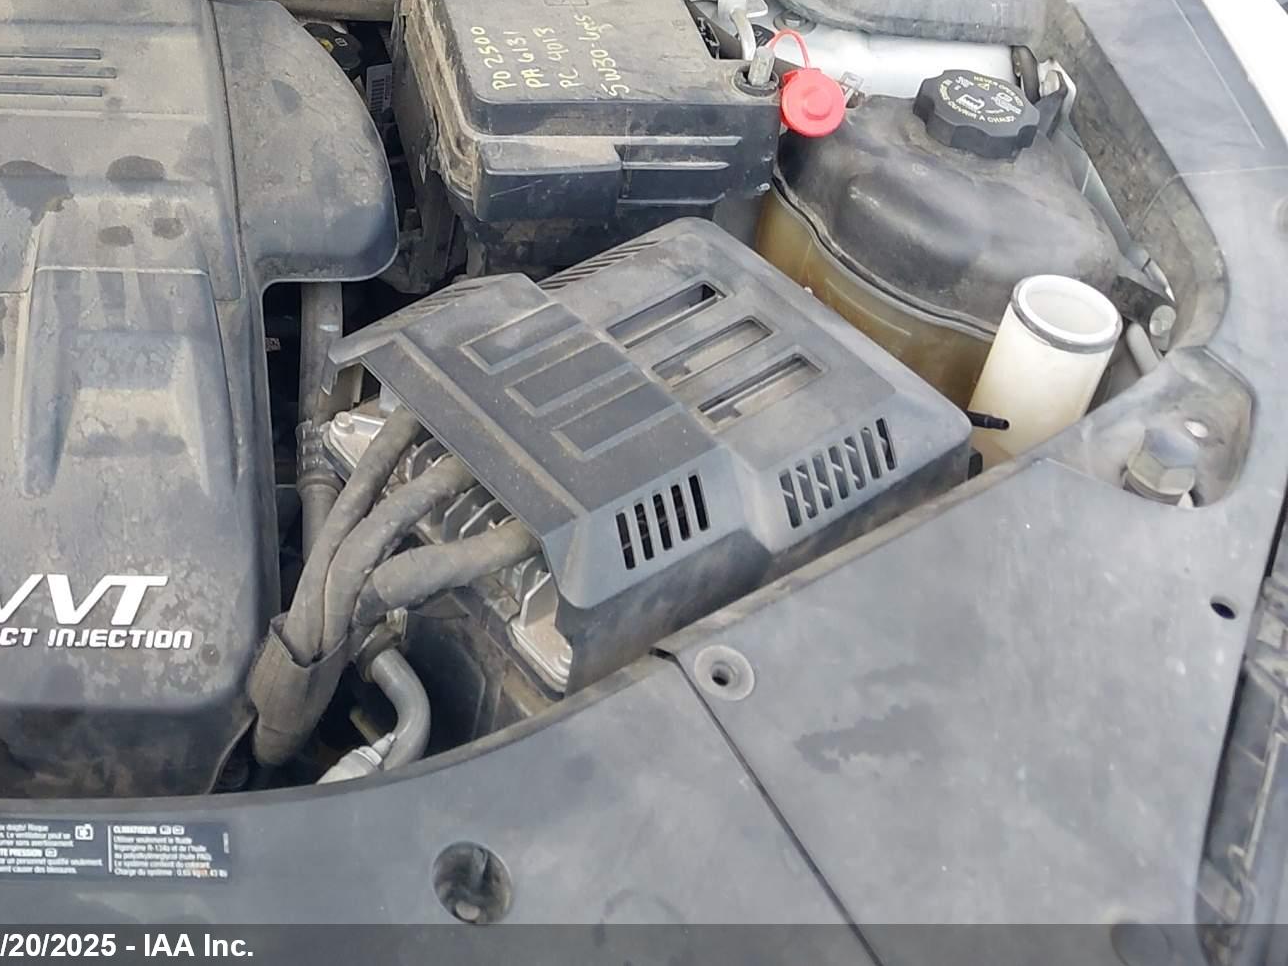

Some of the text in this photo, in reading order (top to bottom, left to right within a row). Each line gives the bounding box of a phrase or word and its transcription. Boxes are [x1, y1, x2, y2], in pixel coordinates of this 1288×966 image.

[470, 26, 504, 68] 2500
[503, 31, 550, 88] PA 6131
[533, 27, 584, 89] PC 4013
[47, 628, 194, 650] INJECTION
